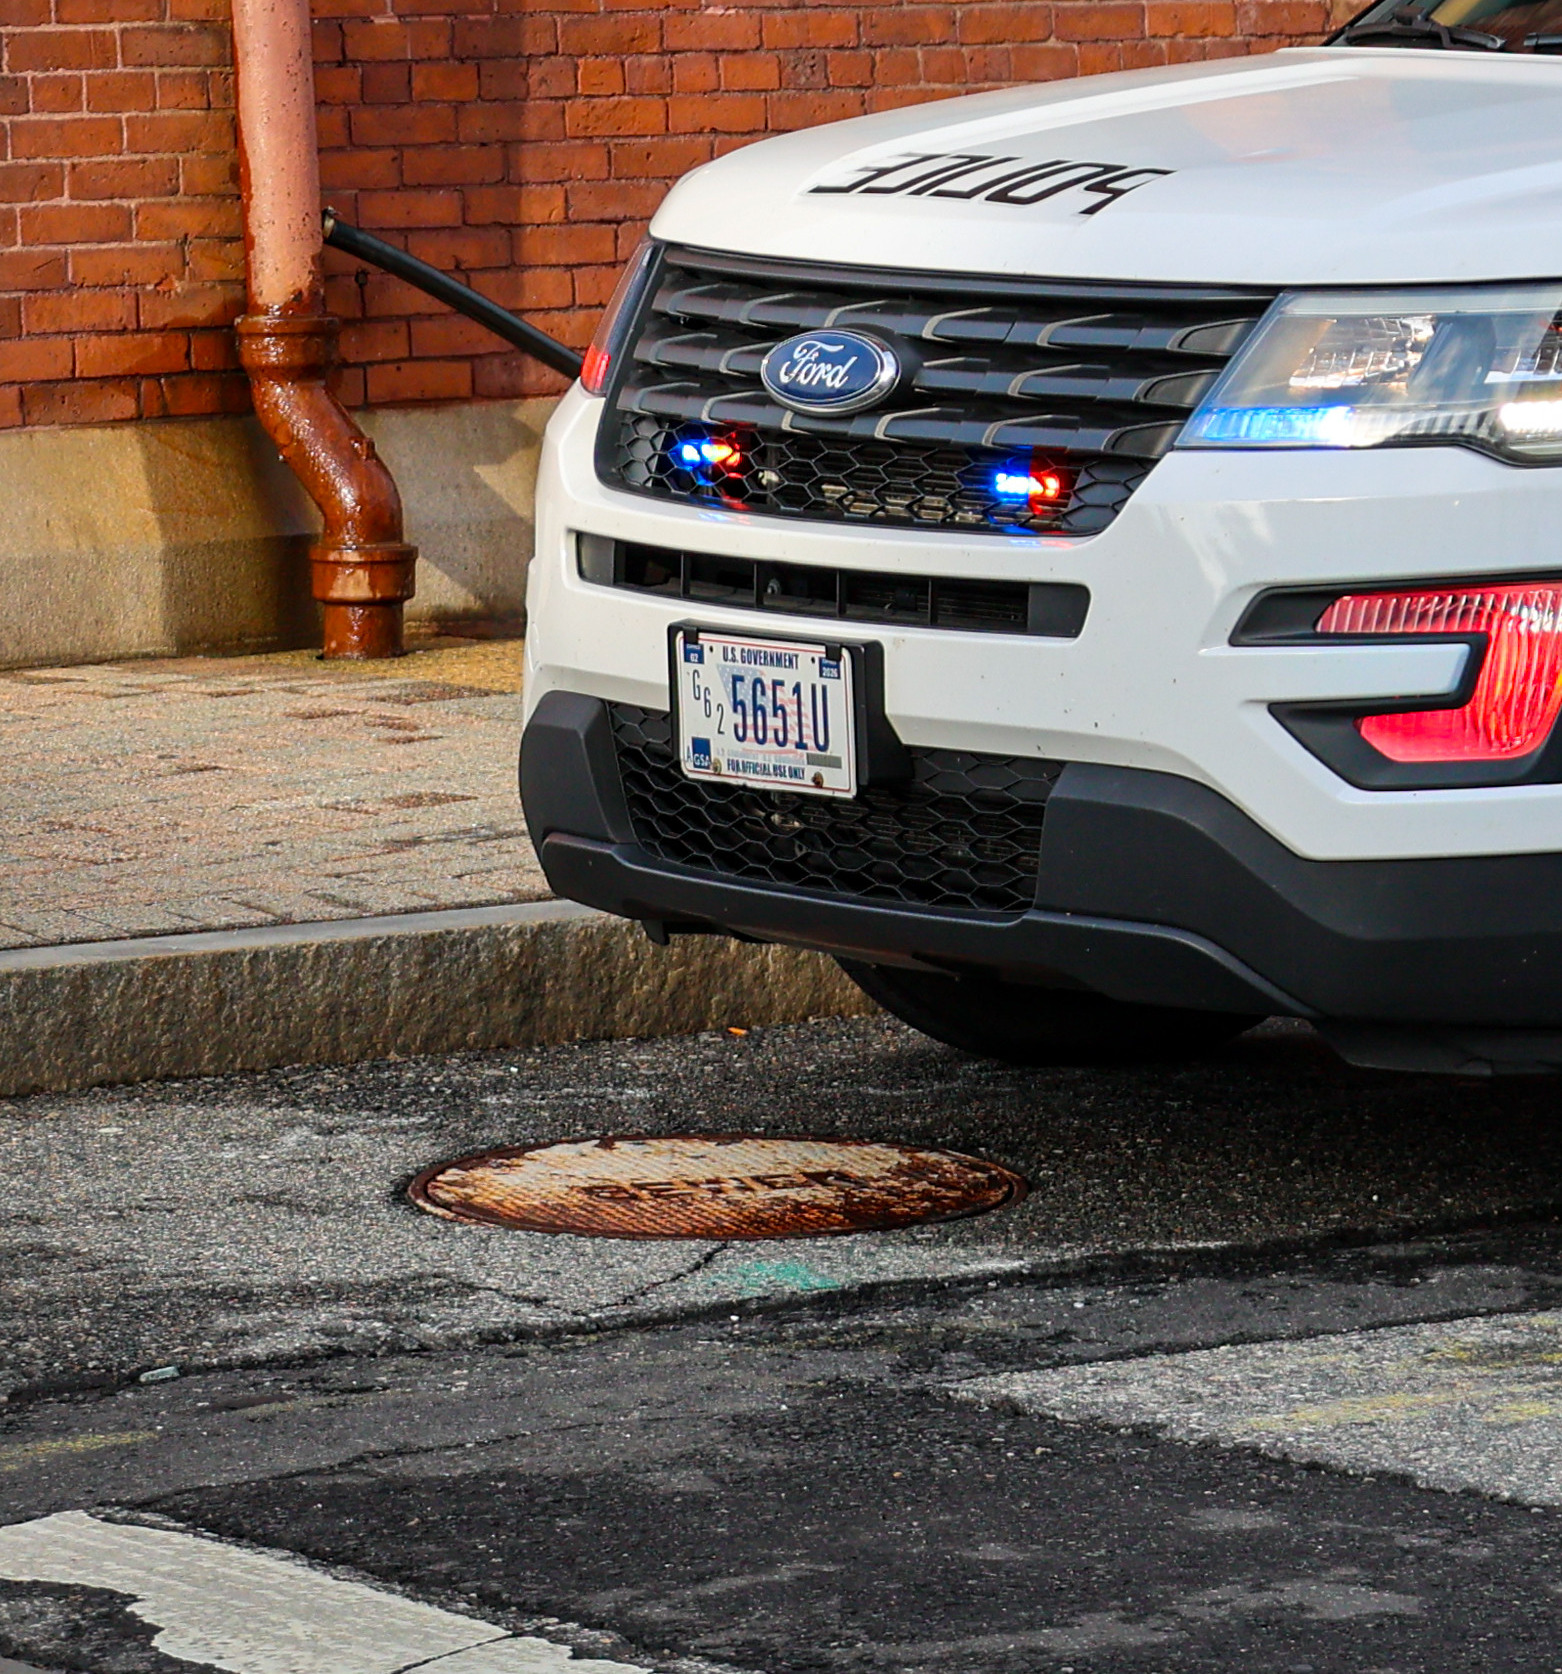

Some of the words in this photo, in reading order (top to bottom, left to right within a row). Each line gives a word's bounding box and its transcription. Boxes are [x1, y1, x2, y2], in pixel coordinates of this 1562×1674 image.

[780, 341, 858, 389] Ford
[722, 645, 739, 664] U.S.
[740, 647, 799, 670] GOVERNMENT
[731, 673, 830, 753] 5651U
[788, 765, 805, 780] ONLY
